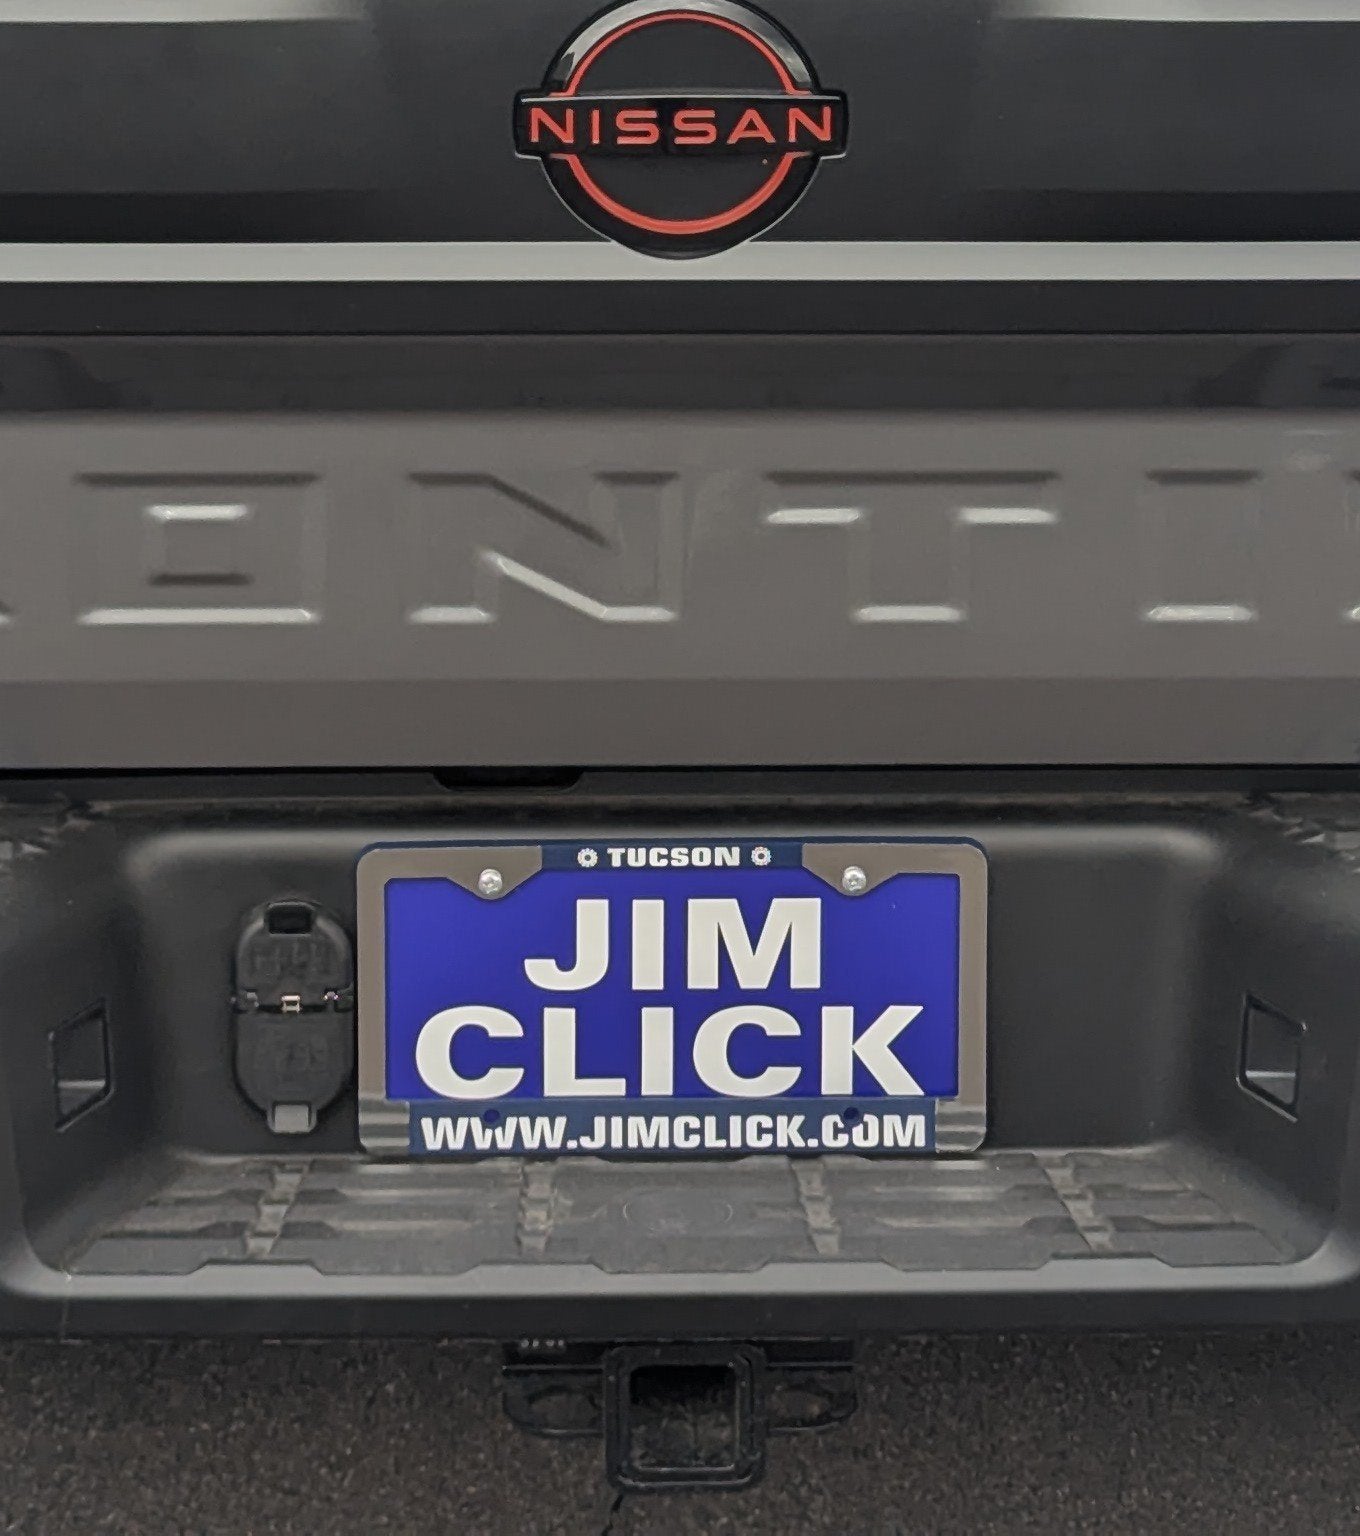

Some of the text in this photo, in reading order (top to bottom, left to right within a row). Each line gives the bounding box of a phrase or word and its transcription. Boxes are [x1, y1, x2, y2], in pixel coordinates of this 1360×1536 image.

[528, 105, 833, 146] NISSAN
[607, 846, 741, 868] TUCSON
[524, 897, 823, 991] JIM
[415, 1004, 926, 1099] CLICK
[419, 1113, 927, 1151] WWW.JIMCLICK.COM
